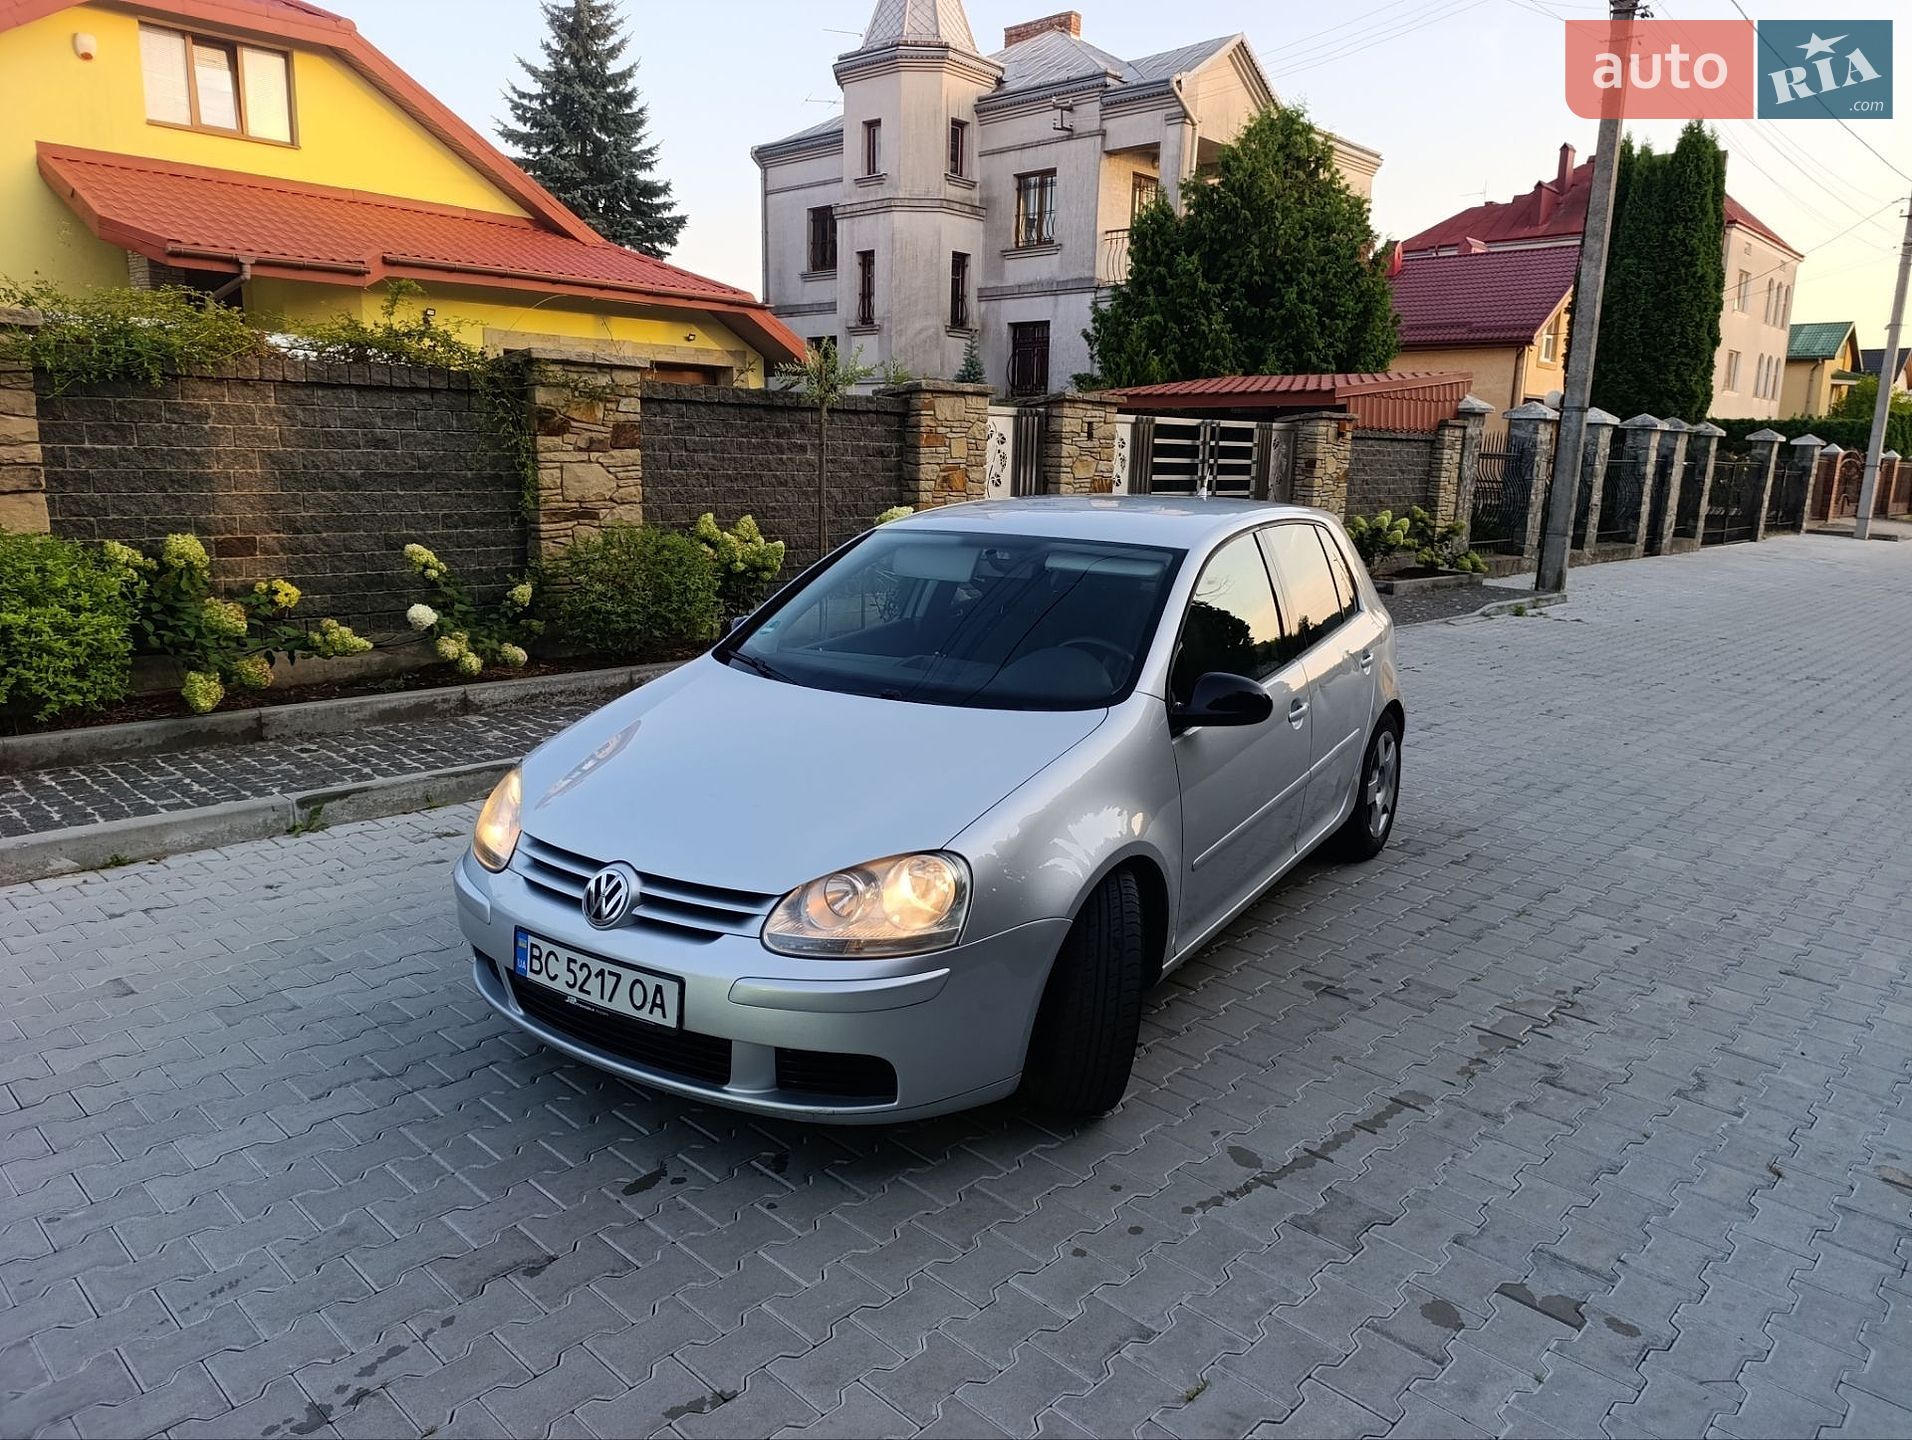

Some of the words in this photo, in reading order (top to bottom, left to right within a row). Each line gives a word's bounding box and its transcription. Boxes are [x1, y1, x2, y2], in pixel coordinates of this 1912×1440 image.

[529, 942, 560, 982] BC
[565, 956, 622, 1003] 5217
[629, 978, 667, 1019] OA
